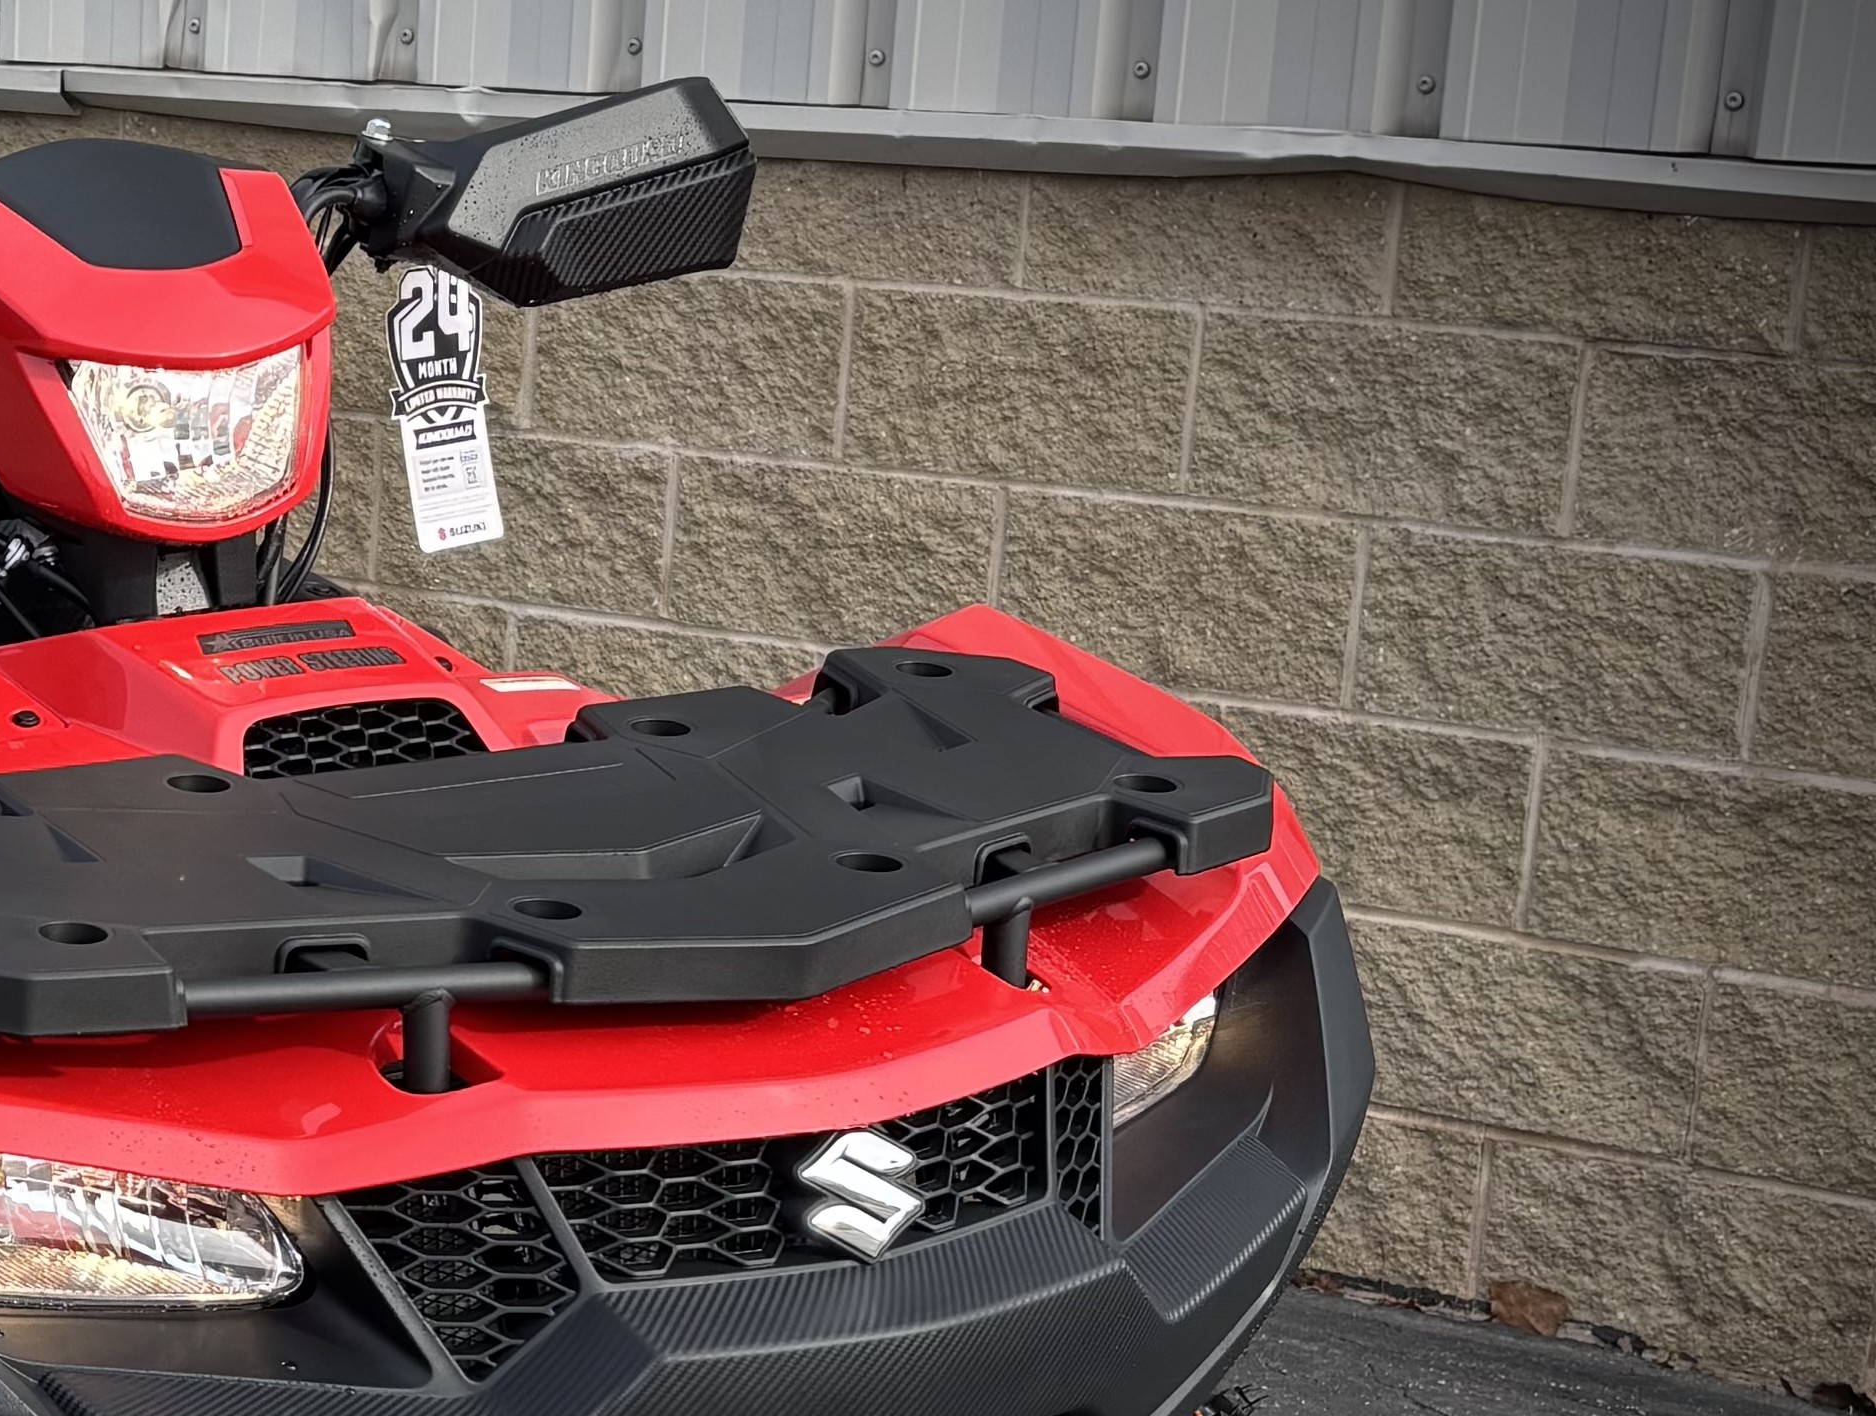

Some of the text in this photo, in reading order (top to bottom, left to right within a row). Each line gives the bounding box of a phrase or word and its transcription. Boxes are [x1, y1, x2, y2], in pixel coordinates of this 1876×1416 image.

[400, 268, 474, 361] 24
[418, 357, 458, 379] MONTH
[287, 632, 306, 643] in
[310, 628, 352, 640] USA
[220, 648, 406, 685] POWER STEERING
